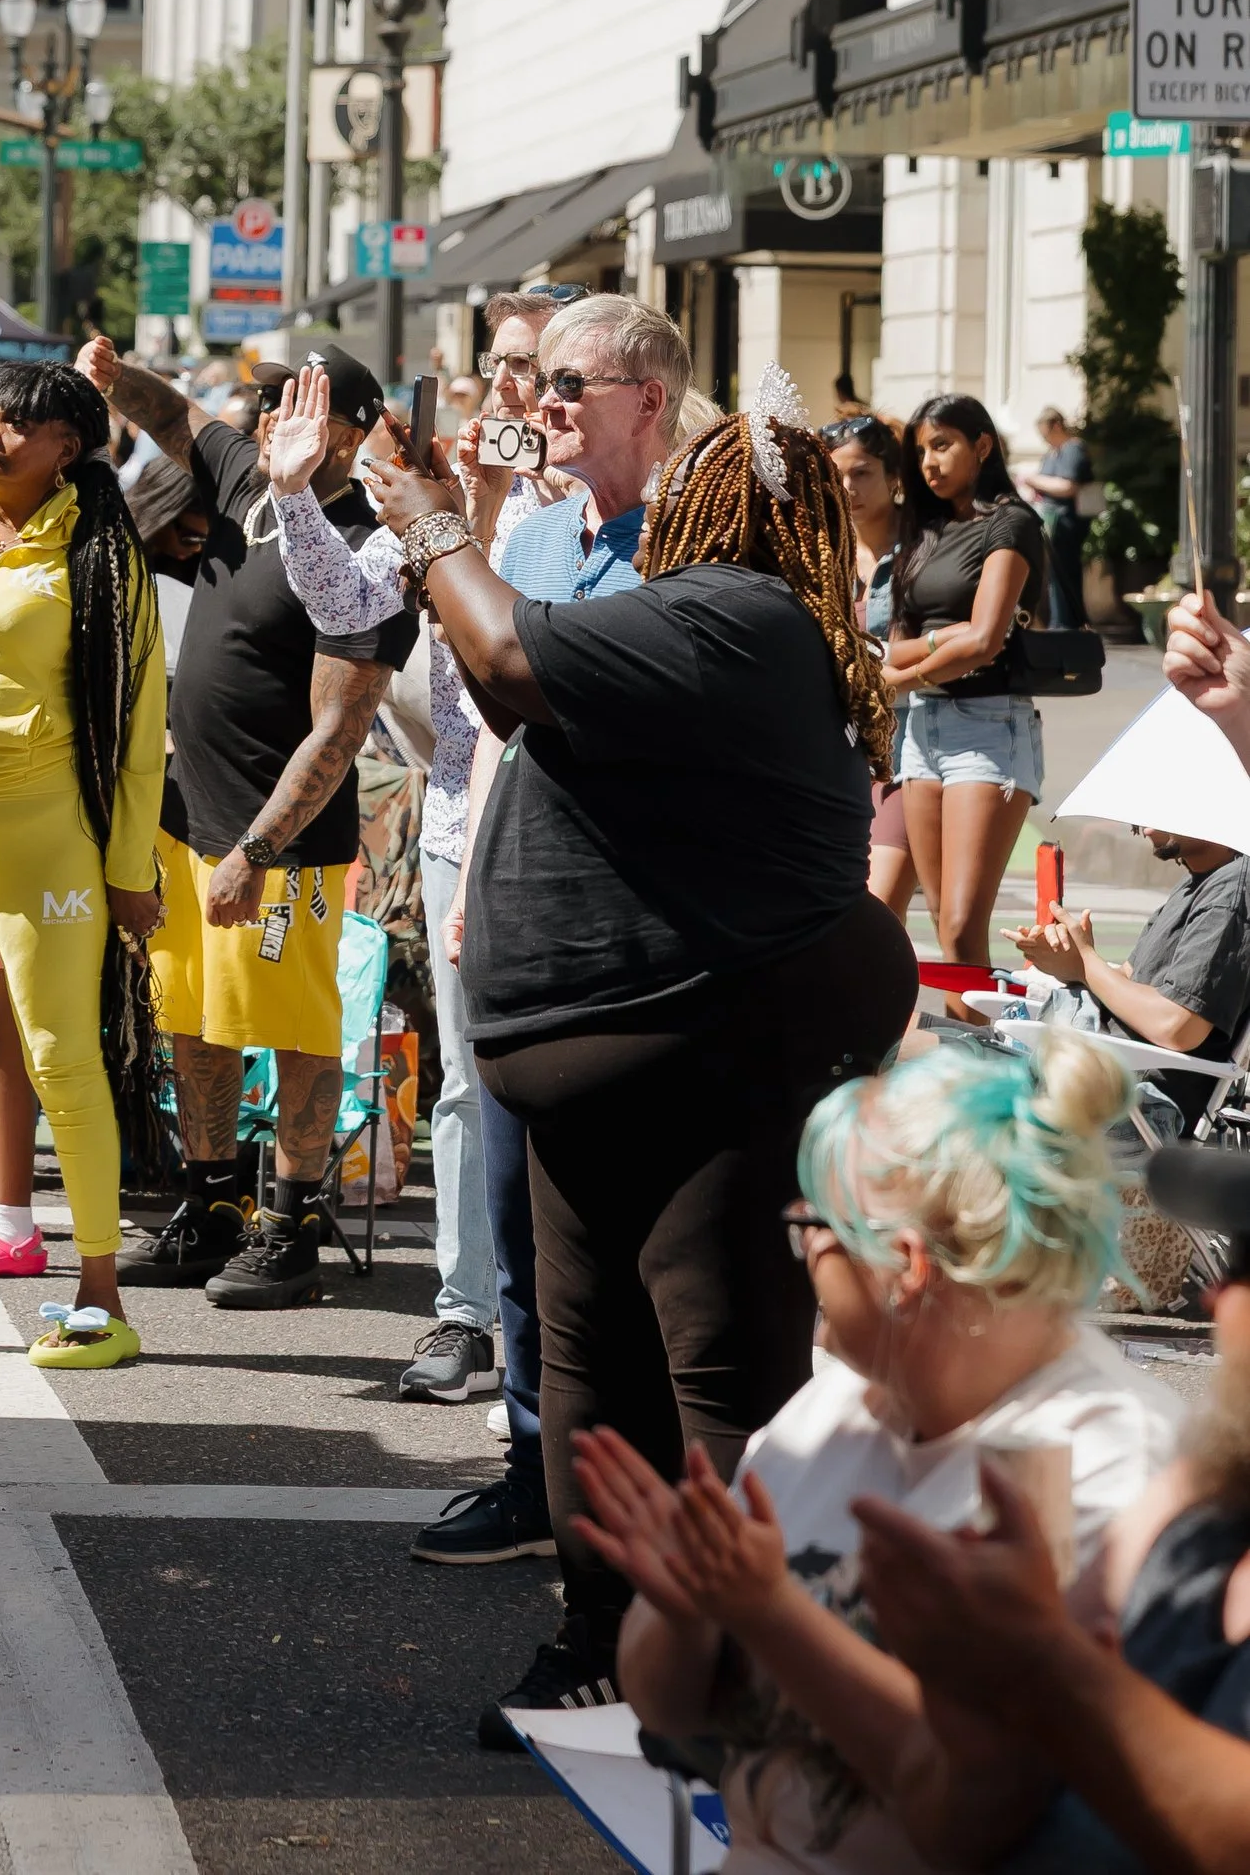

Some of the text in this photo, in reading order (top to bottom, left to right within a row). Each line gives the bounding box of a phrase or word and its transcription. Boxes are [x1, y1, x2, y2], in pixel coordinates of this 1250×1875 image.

[1146, 29, 1196, 69] ON
[1149, 80, 1206, 103] EXCEPT
[1129, 120, 1181, 153] Broadway
[43, 888, 93, 918] MK
[259, 914, 288, 962] NIKE
